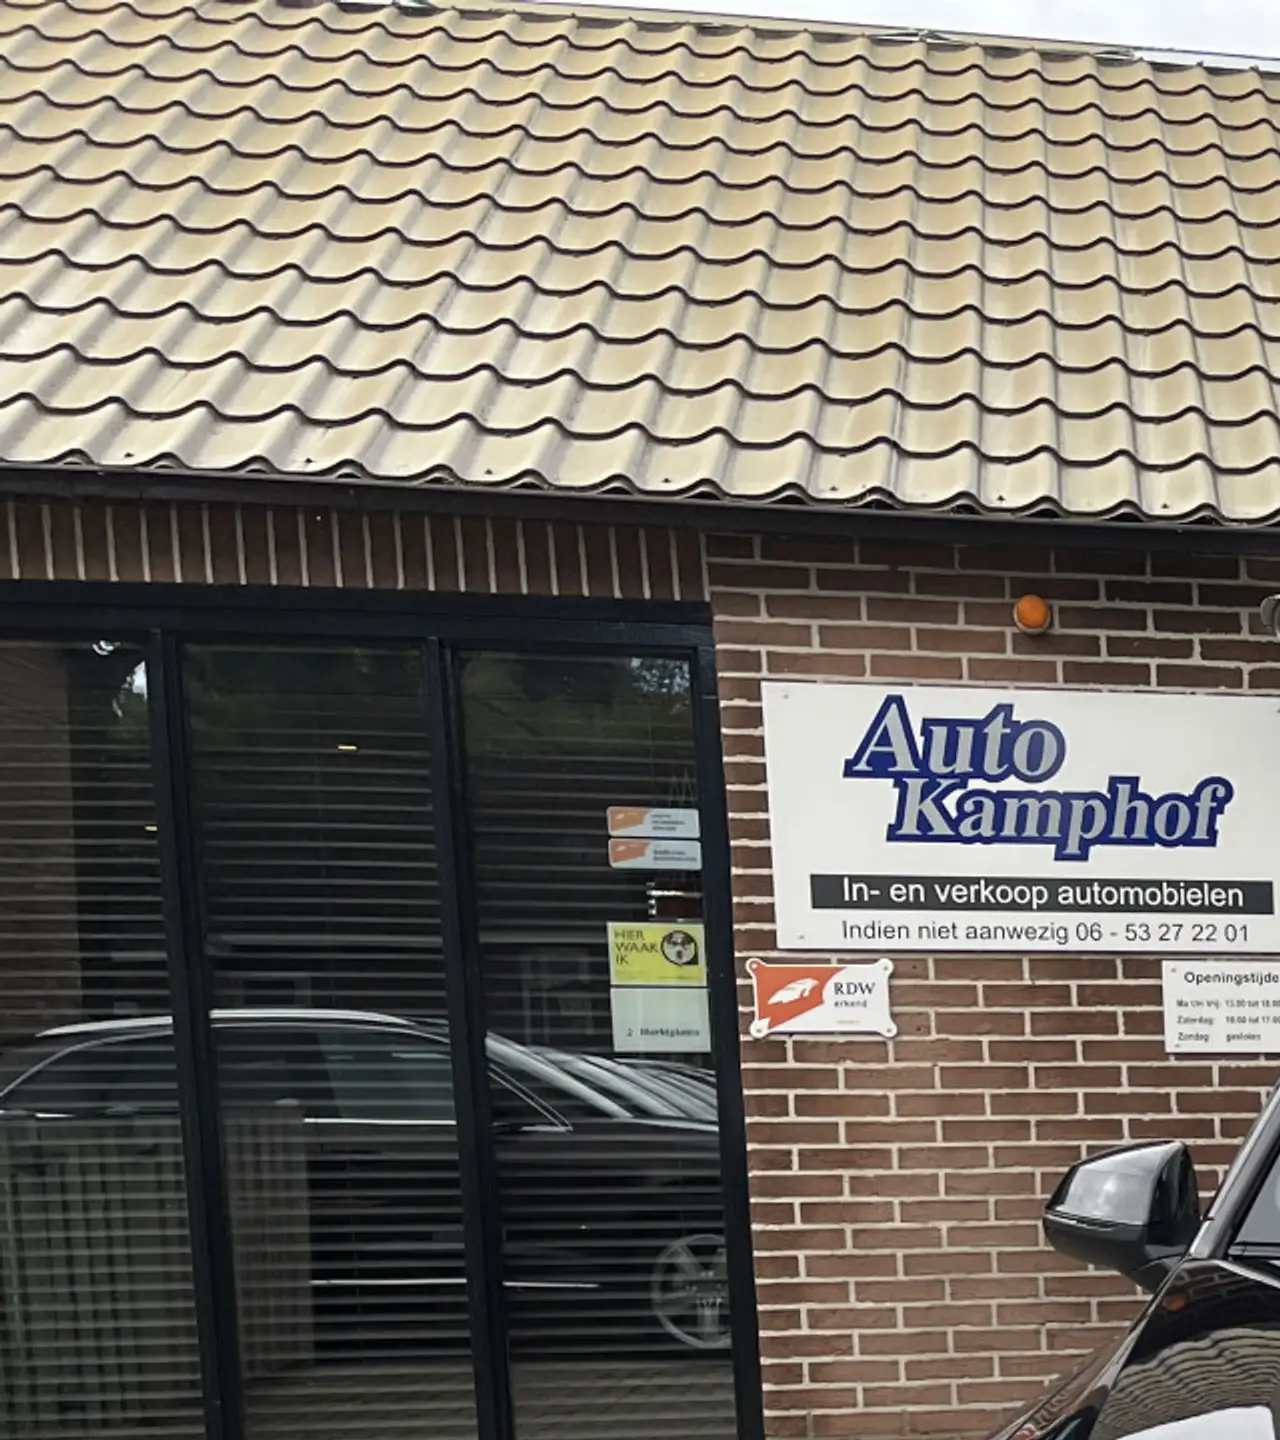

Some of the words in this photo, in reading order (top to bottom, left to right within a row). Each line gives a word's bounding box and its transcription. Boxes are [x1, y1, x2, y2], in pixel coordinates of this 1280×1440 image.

[843, 694, 1066, 783] Auto
[887, 776, 1234, 861] Kamphof
[843, 876, 881, 901] In-
[889, 882, 925, 902] en
[934, 878, 1049, 910] verkoop
[1057, 881, 1244, 907] automobielen
[614, 930, 645, 941] HIER
[842, 920, 909, 939] Indien
[918, 921, 958, 939] niet
[965, 922, 1068, 945] aanwezig
[1075, 921, 1103, 942] 06
[1125, 923, 1150, 942] 53
[1158, 923, 1183, 942] 27
[1191, 923, 1218, 943] 22
[1224, 923, 1248, 942] 01
[615, 942, 659, 954] WAAK
[616, 954, 629, 965] IK
[833, 982, 876, 996] RDW
